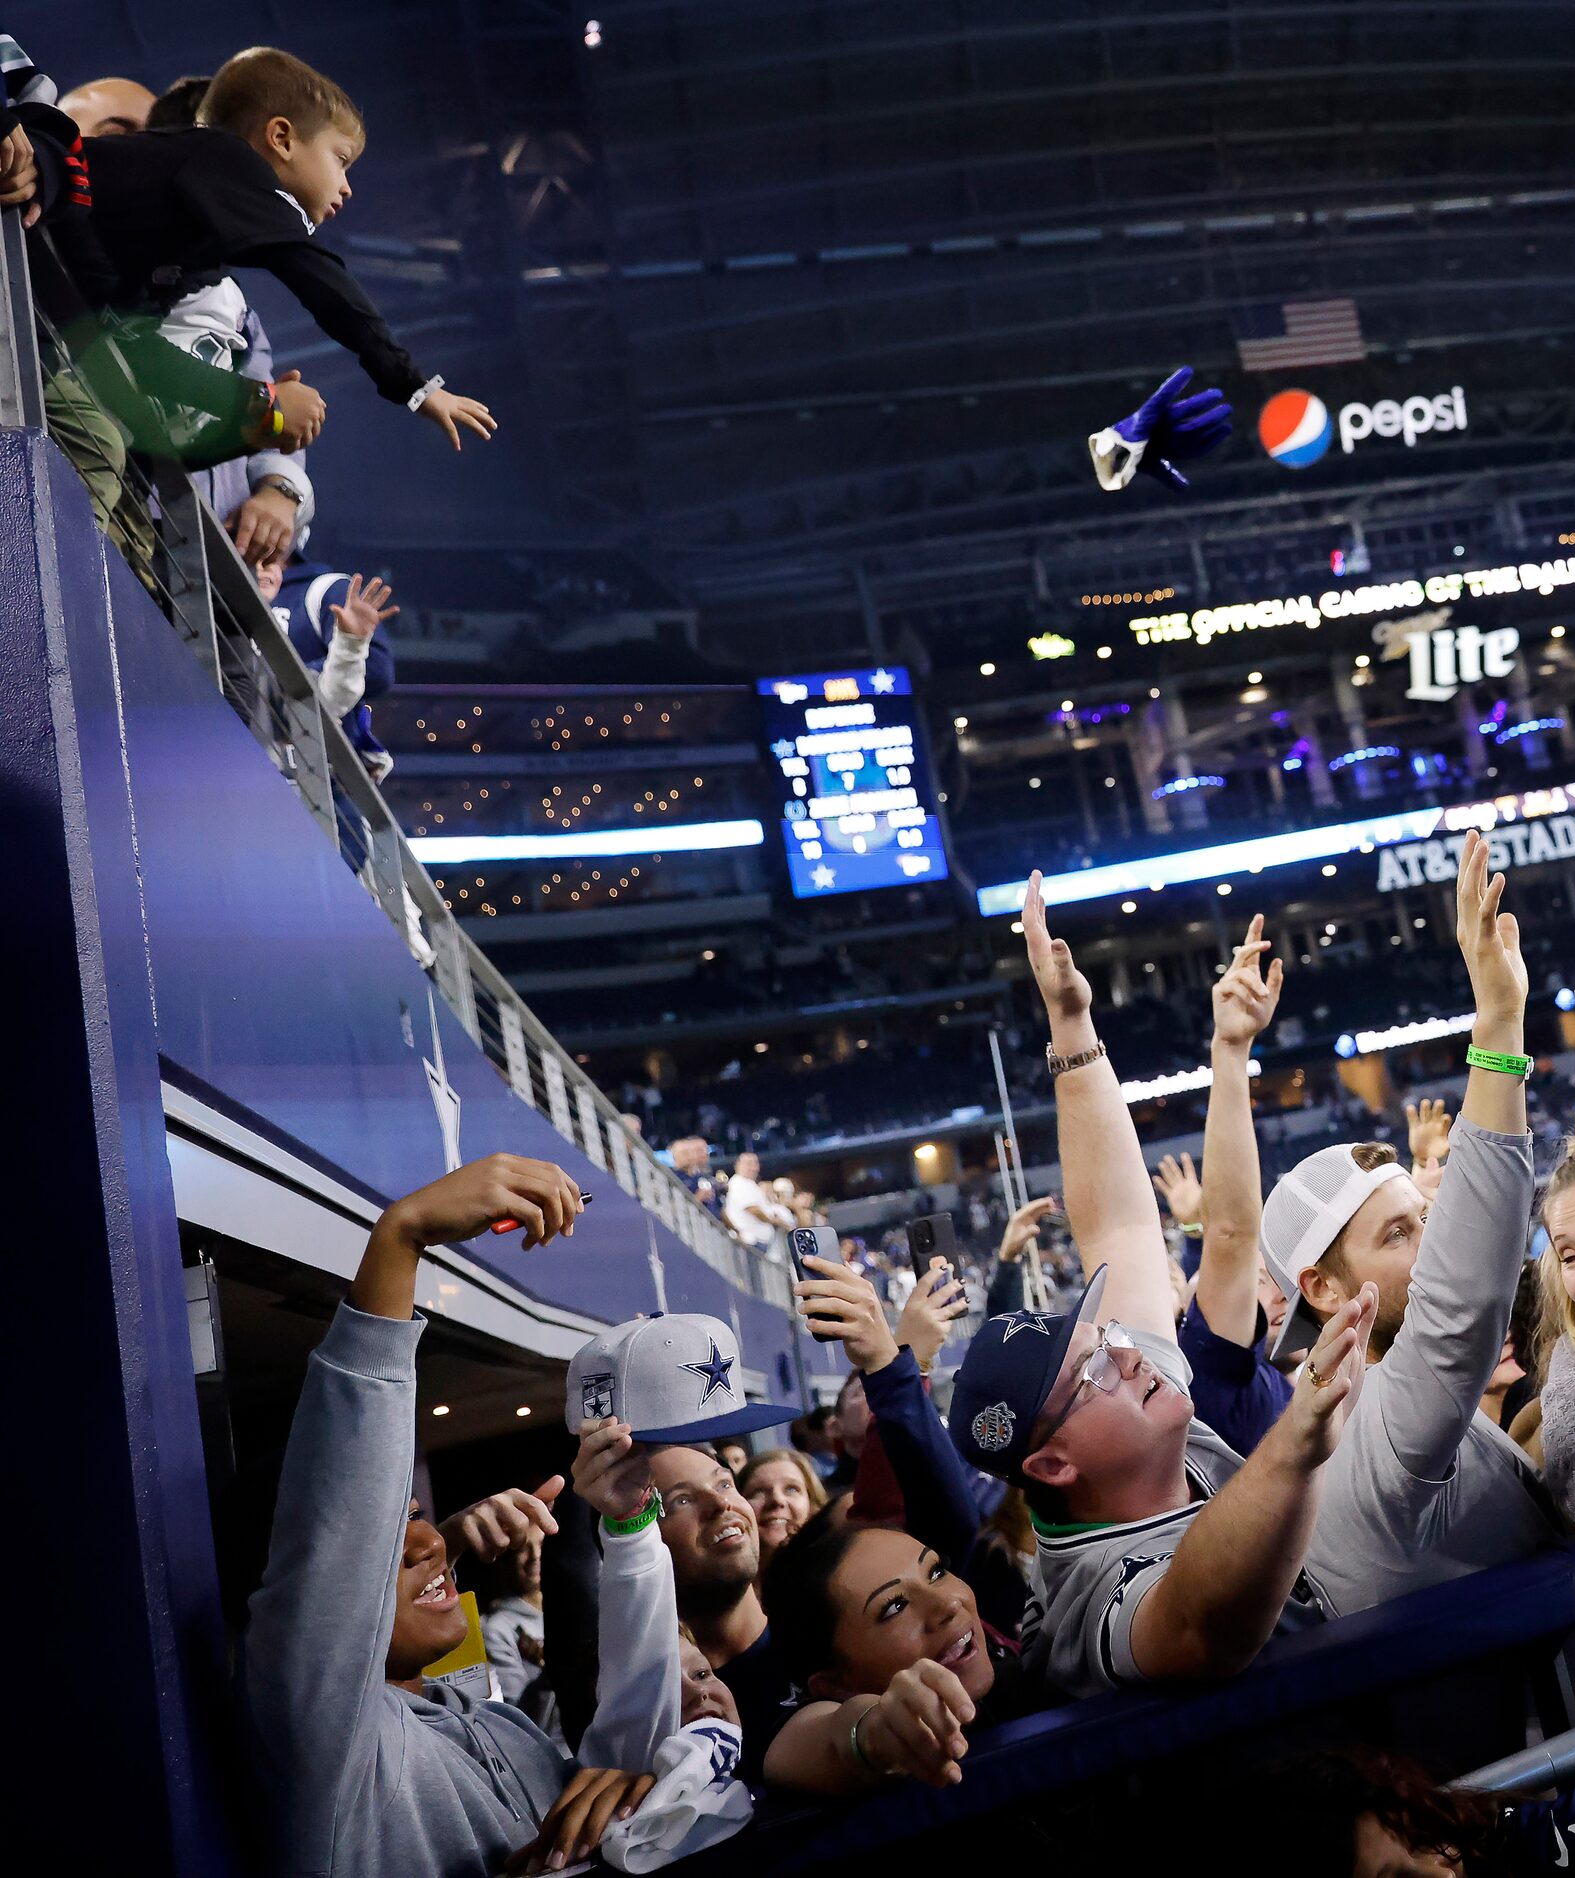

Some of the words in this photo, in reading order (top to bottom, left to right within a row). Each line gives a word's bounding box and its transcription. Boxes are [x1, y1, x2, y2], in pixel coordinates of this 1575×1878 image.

[1339, 385, 1468, 454] pepsi
[1129, 612, 1192, 645] THE
[1191, 595, 1321, 640] OFFICIAL
[1319, 580, 1425, 618] CASINO
[1424, 574, 1463, 602] OF
[1463, 566, 1521, 598] THE
[1404, 625, 1520, 702] Lite
